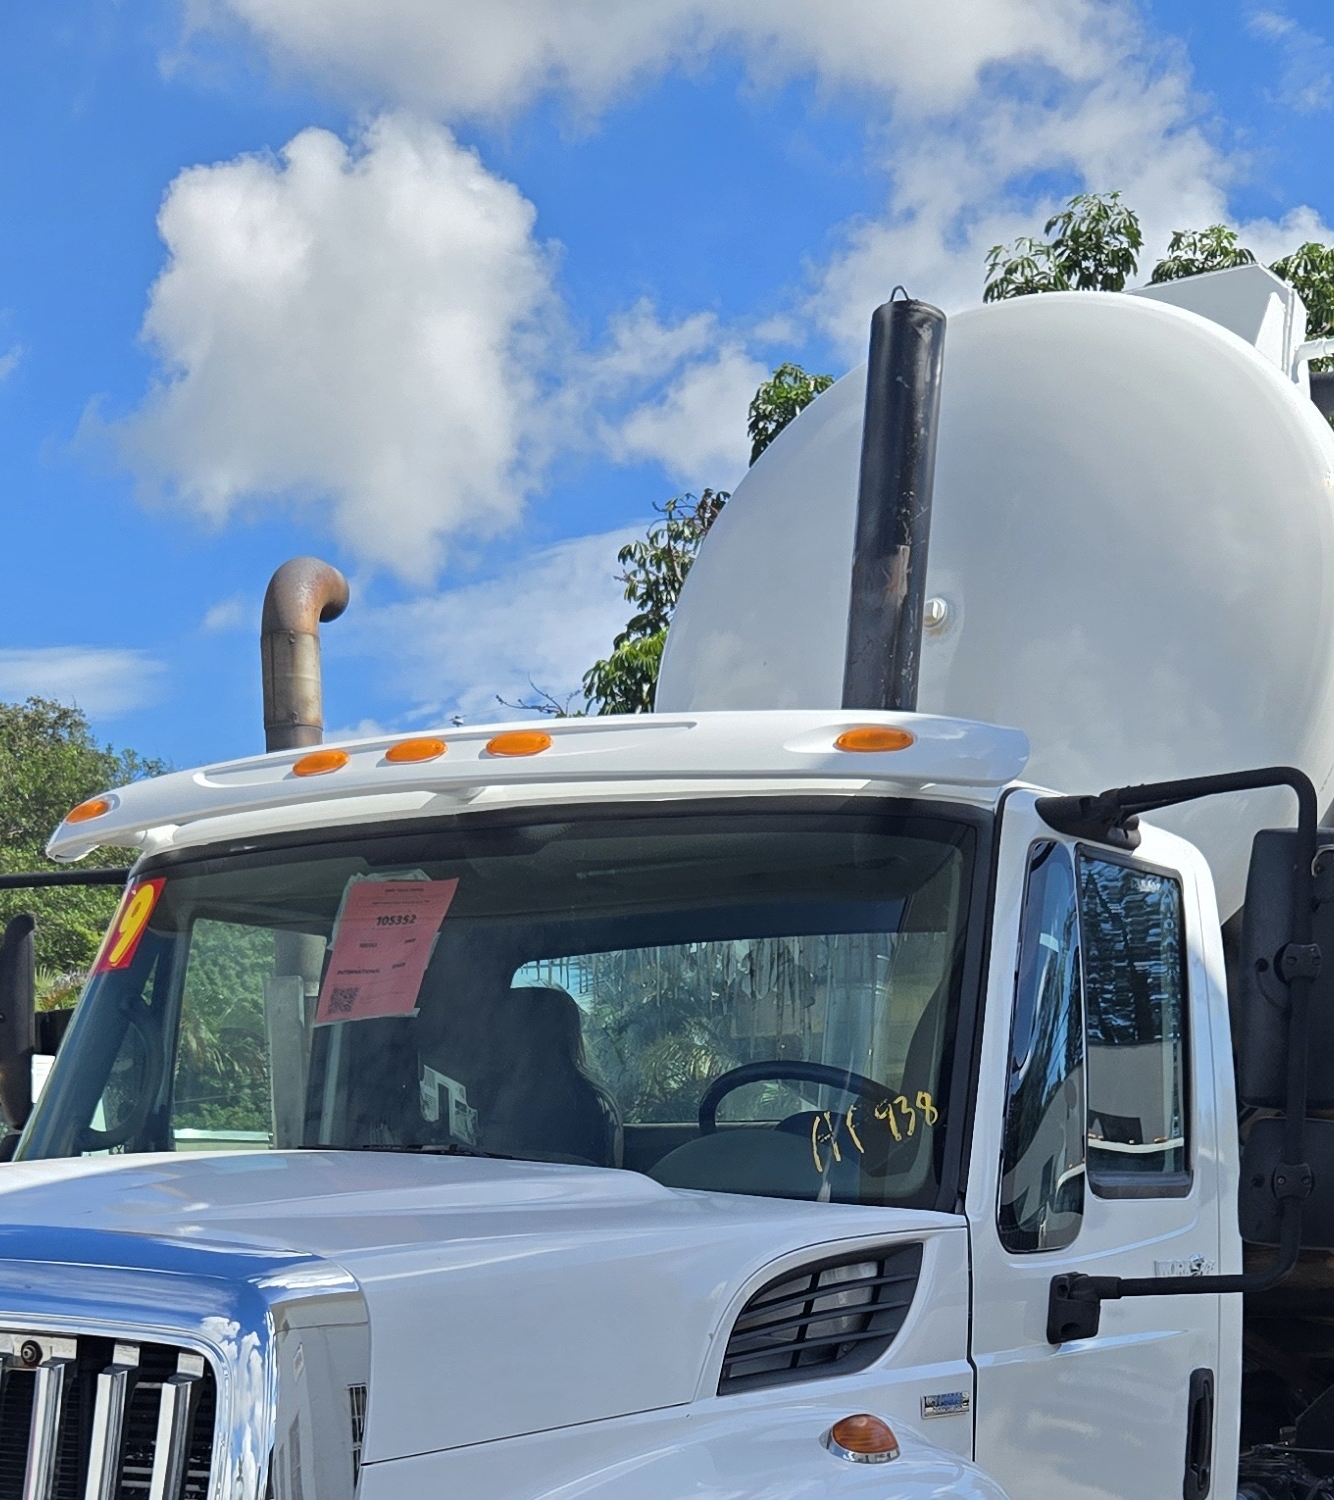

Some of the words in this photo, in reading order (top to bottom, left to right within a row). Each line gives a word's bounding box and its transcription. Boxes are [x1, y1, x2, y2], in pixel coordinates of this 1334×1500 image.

[109, 884, 154, 967] 9
[376, 914, 417, 926] 105352
[874, 1090, 938, 1141] 938
